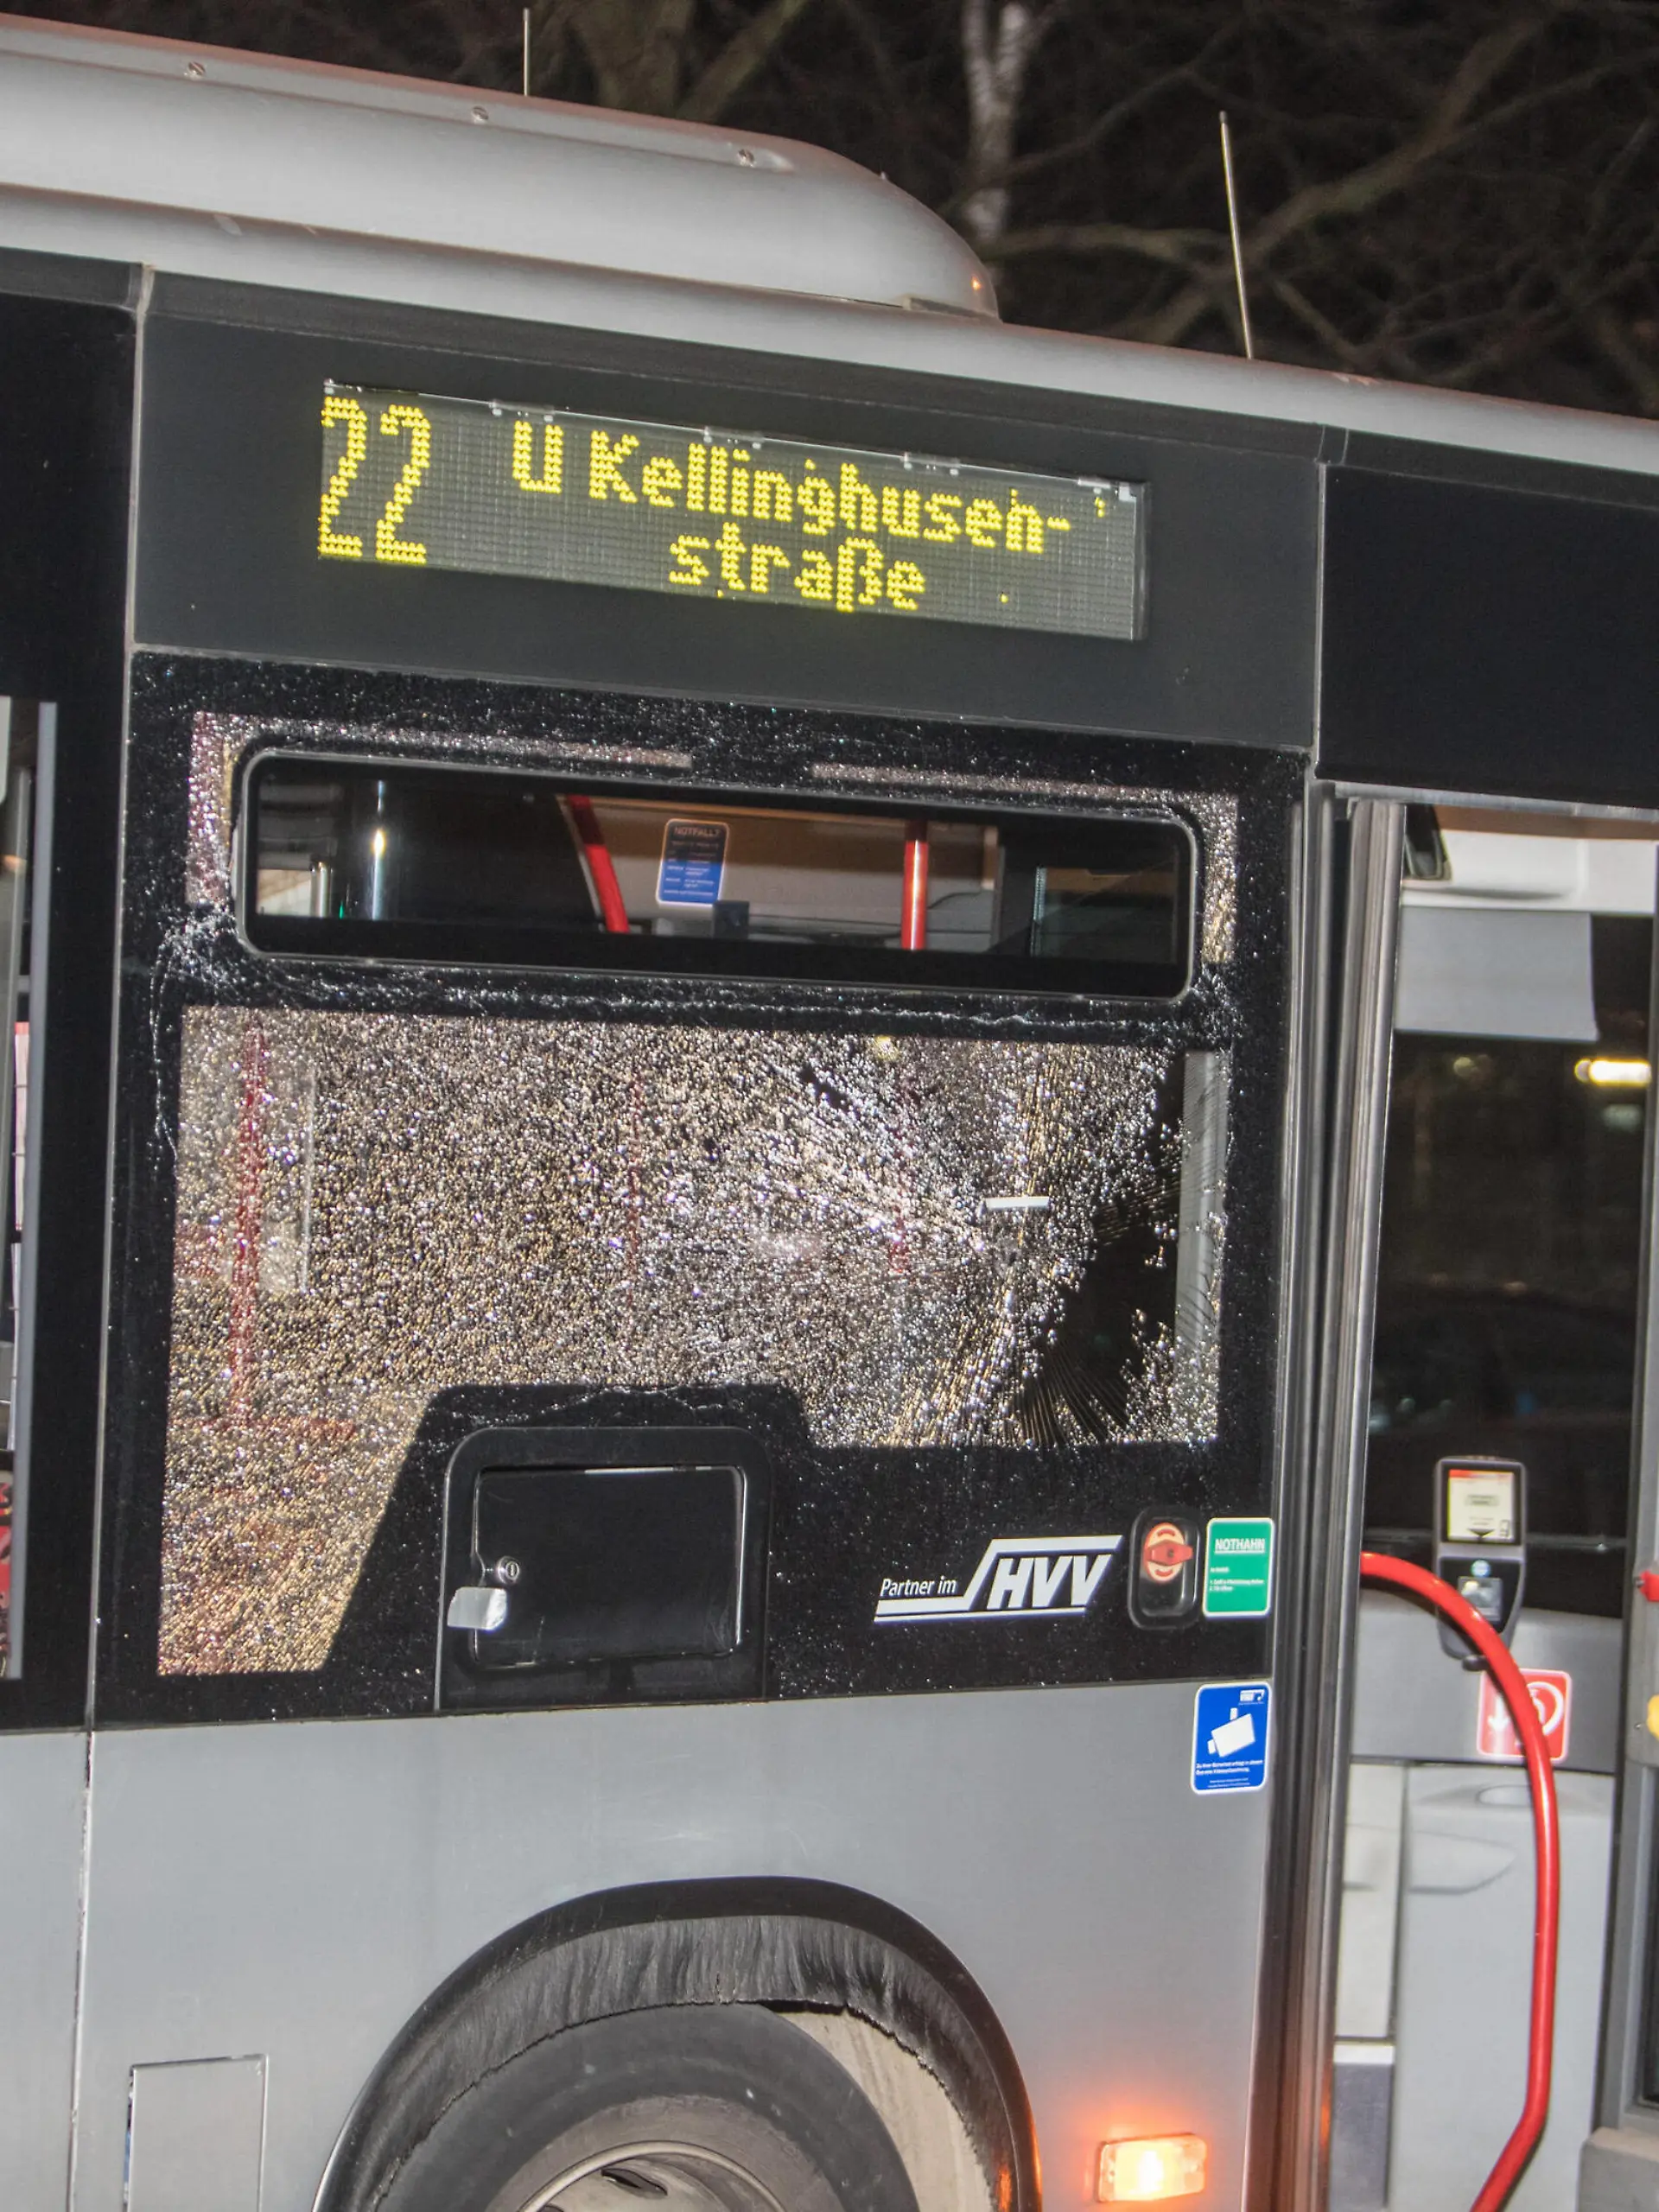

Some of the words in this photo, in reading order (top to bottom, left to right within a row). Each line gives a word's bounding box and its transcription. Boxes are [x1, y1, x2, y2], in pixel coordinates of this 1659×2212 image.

[320, 396, 431, 566] 22
[512, 420, 563, 494] U
[589, 429, 1071, 554] Kellinghusen-
[669, 521, 925, 613] straße
[1214, 1538, 1266, 1551] NOTHAHN
[880, 1578, 935, 1597] Partner
[938, 1575, 957, 1594] im
[986, 1554, 1112, 1611] HVV
